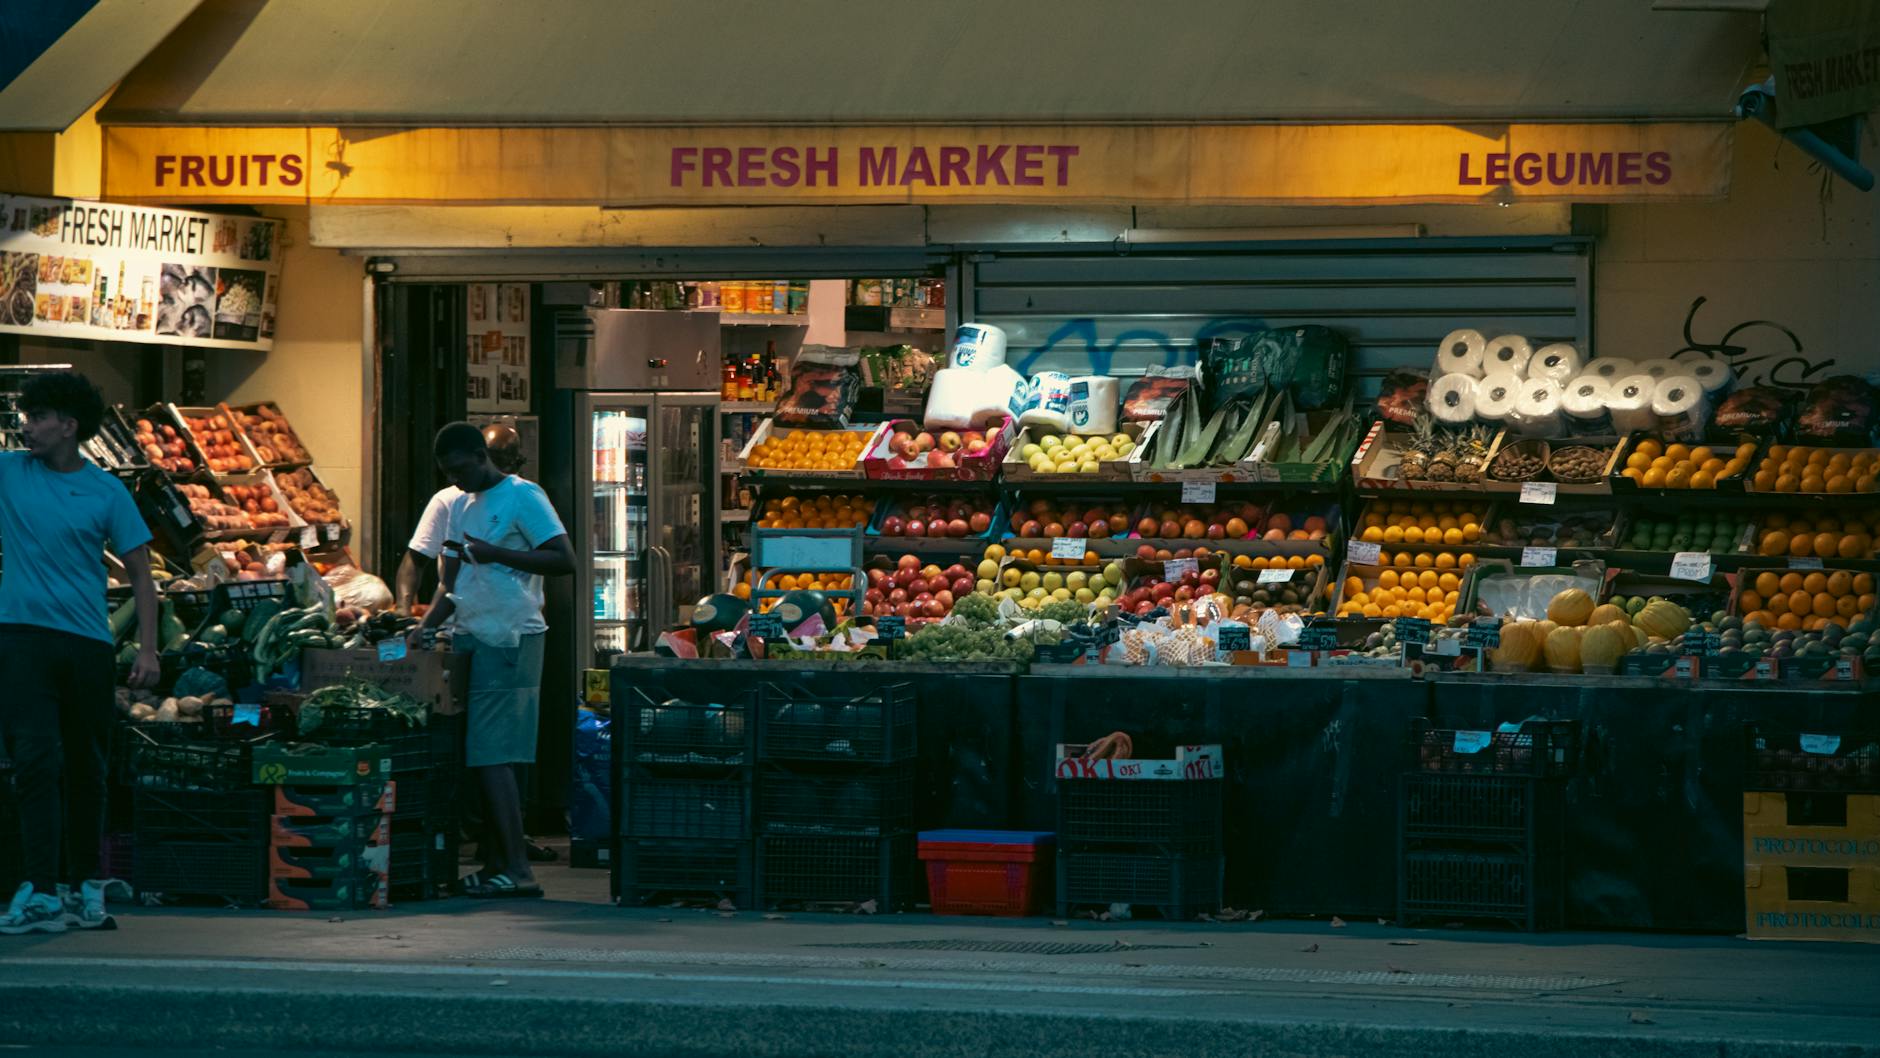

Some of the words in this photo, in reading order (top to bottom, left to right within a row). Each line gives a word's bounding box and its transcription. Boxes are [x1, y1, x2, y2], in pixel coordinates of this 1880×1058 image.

[1785, 61, 1823, 99] FRESH
[155, 154, 303, 187] FRUITS
[670, 146, 838, 188] FRESH
[859, 145, 1080, 188] MARKET
[1458, 151, 1672, 186] LEGUMES
[61, 205, 124, 247] FRESH
[129, 212, 209, 255] MARKET
[1057, 758, 1115, 779] OKI
[1119, 764, 1142, 776] OKI
